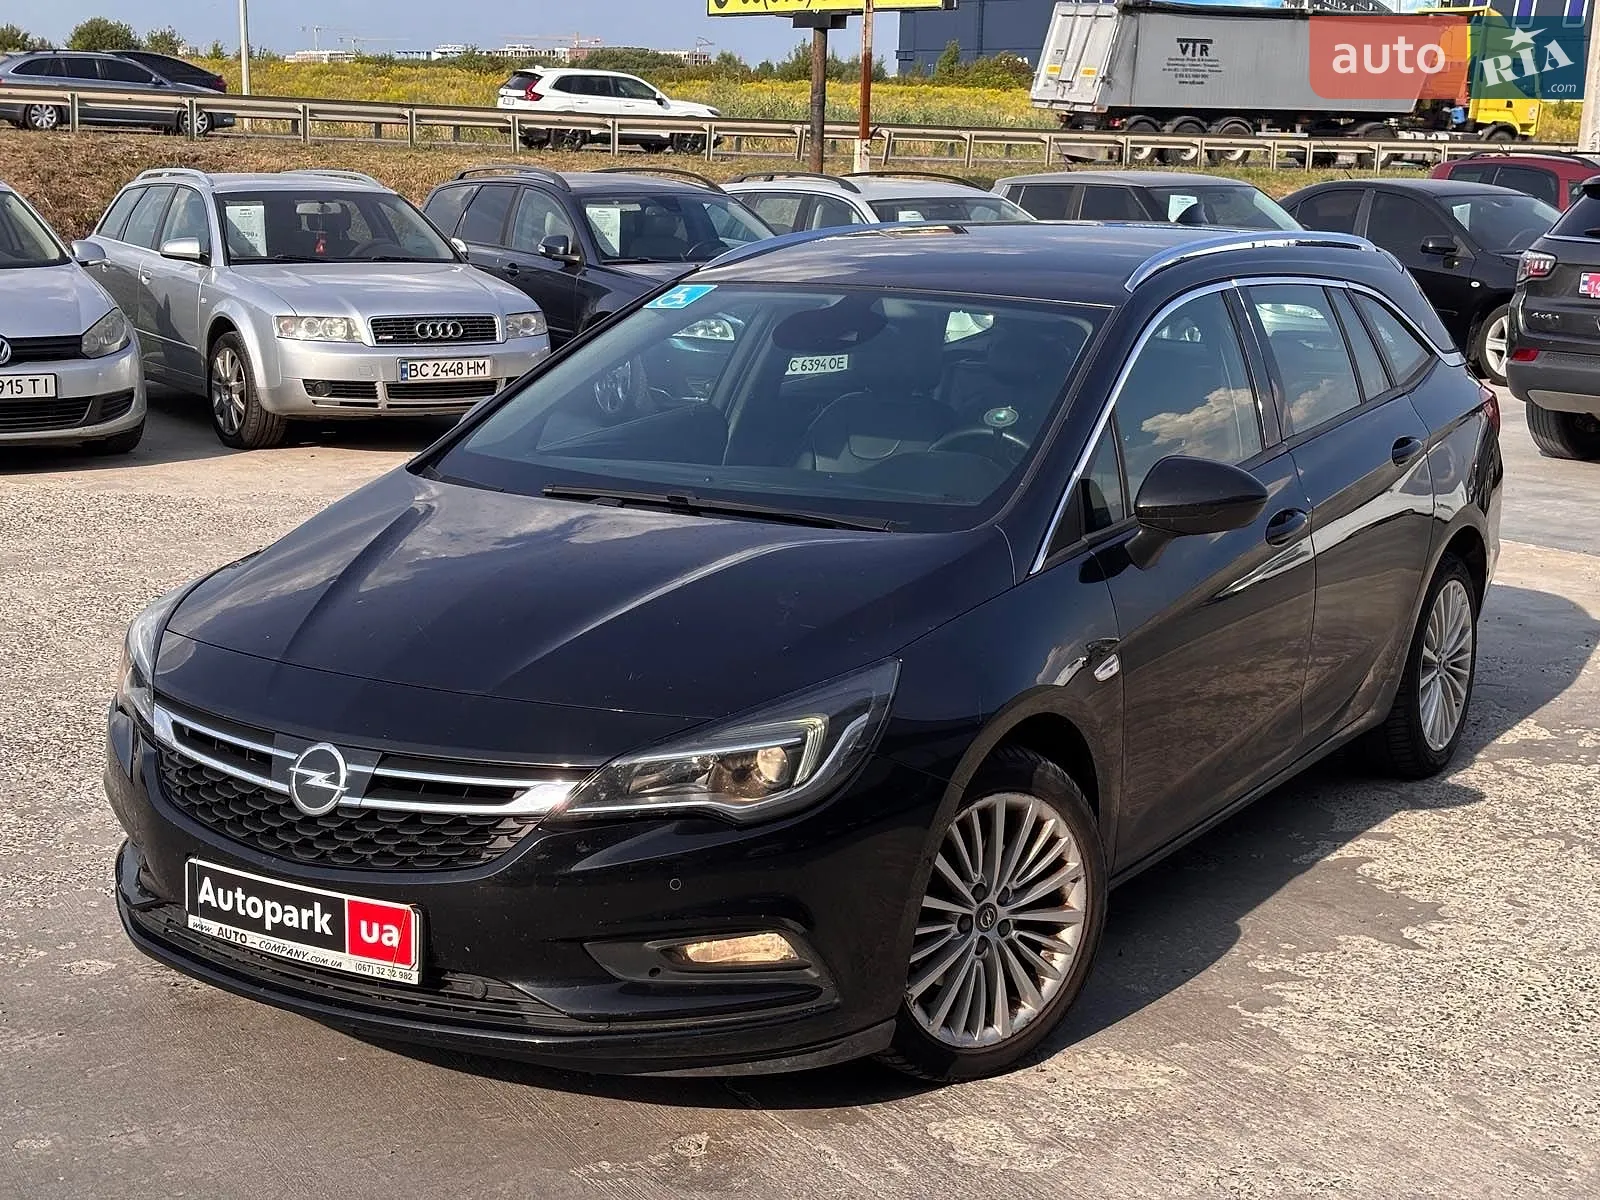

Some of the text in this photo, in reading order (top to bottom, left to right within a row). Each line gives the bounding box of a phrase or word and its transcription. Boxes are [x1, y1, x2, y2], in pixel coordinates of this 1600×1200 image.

[1176, 37, 1213, 57] VTR
[408, 360, 486, 378] BC 2448 HM
[800, 358, 827, 372] 6394
[829, 356, 845, 370] OE
[199, 876, 400, 948] Autopark ua
[217, 926, 248, 944] AUTO
[354, 962, 374, 975] (067)
[376, 966, 385, 976] 32
[398, 970, 413, 981] 982
